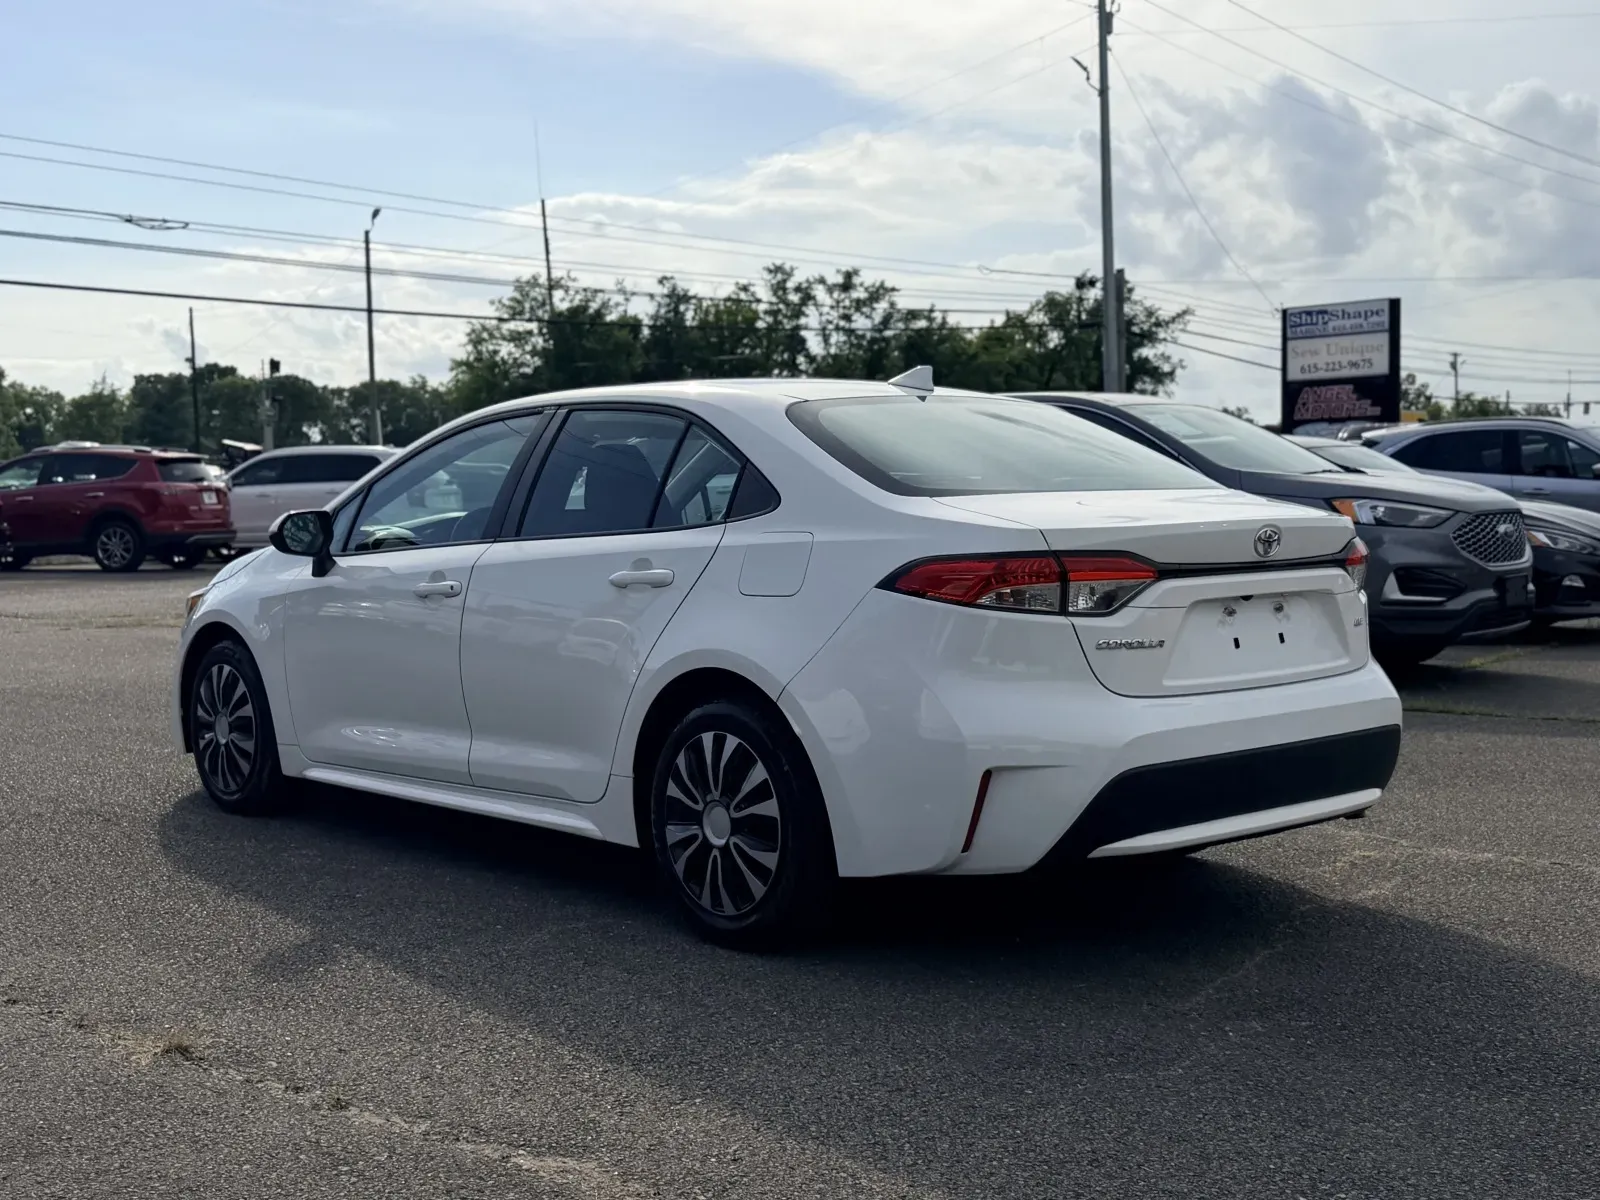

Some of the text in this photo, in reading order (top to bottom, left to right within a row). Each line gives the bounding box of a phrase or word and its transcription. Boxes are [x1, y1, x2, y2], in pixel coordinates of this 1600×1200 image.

[1289, 308, 1385, 326] ShipShape
[1325, 342, 1385, 357] Unique
[1300, 358, 1374, 374] 615-223-9675
[1298, 384, 1357, 402] ANGEL
[1293, 400, 1372, 420] MOTORS
[1095, 638, 1165, 650] COROLLA
